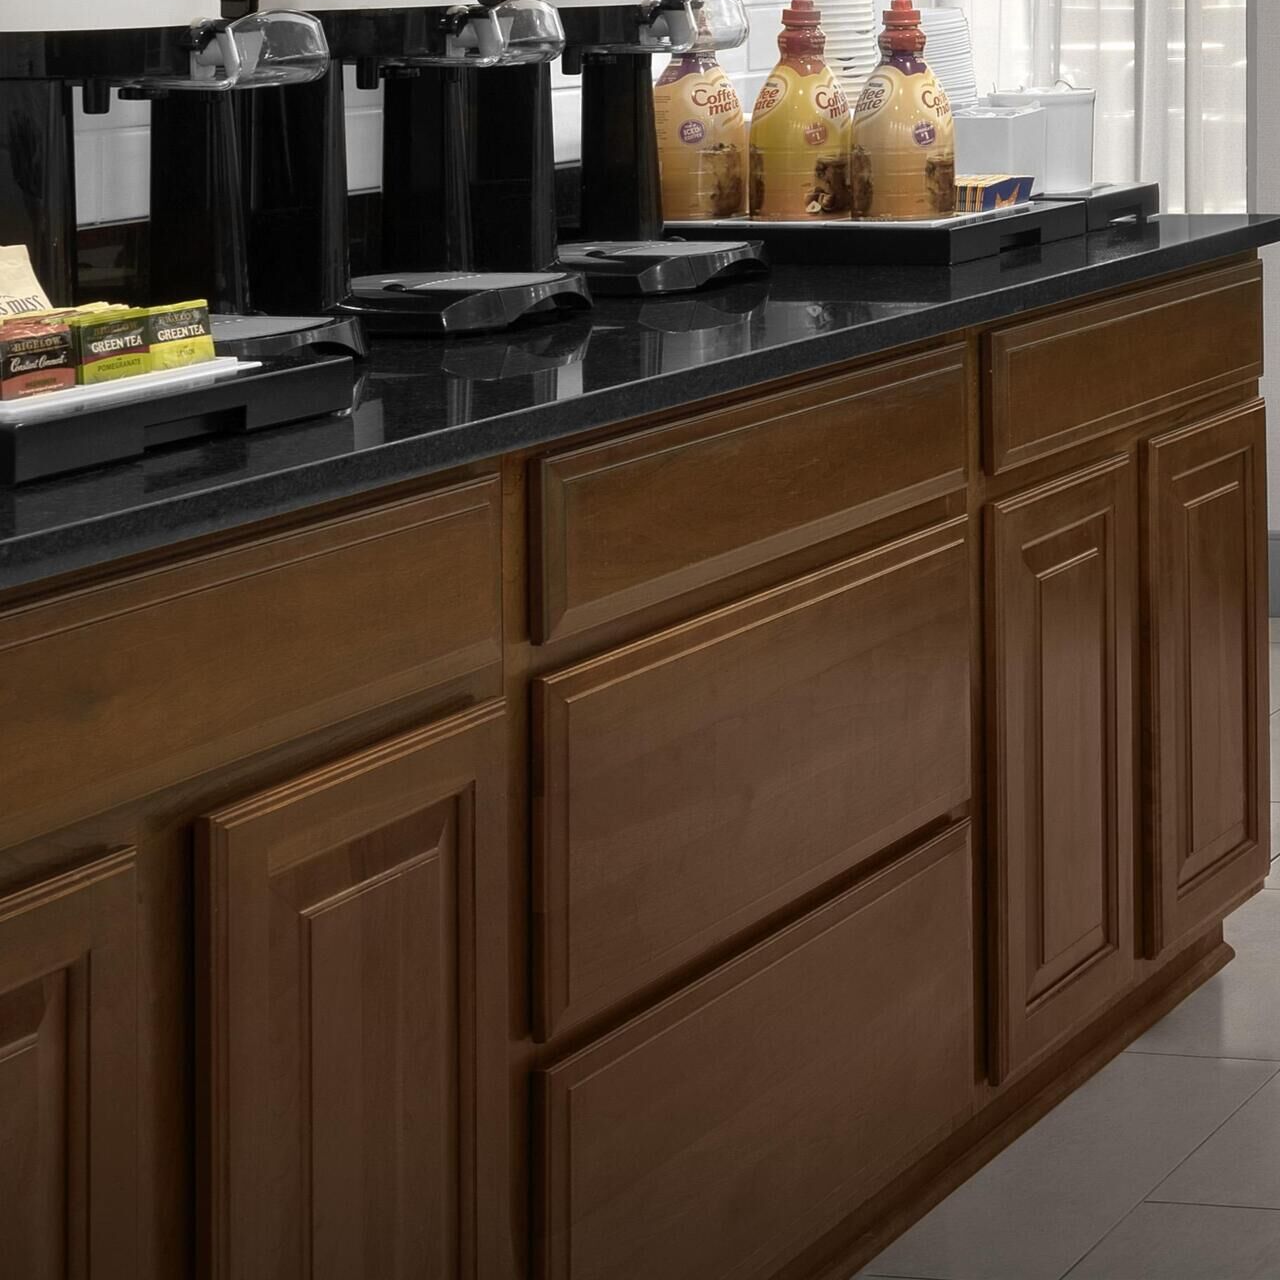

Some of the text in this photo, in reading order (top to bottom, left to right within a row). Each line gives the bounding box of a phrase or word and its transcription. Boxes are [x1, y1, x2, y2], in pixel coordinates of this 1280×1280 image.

[691, 88, 737, 107] Coffee
[755, 98, 776, 110] ate
[708, 99, 739, 115] mate
[157, 324, 206, 341] GREEN TEA
[13, 336, 62, 353] BIGELOW
[91, 335, 144, 353] GREEN TEA
